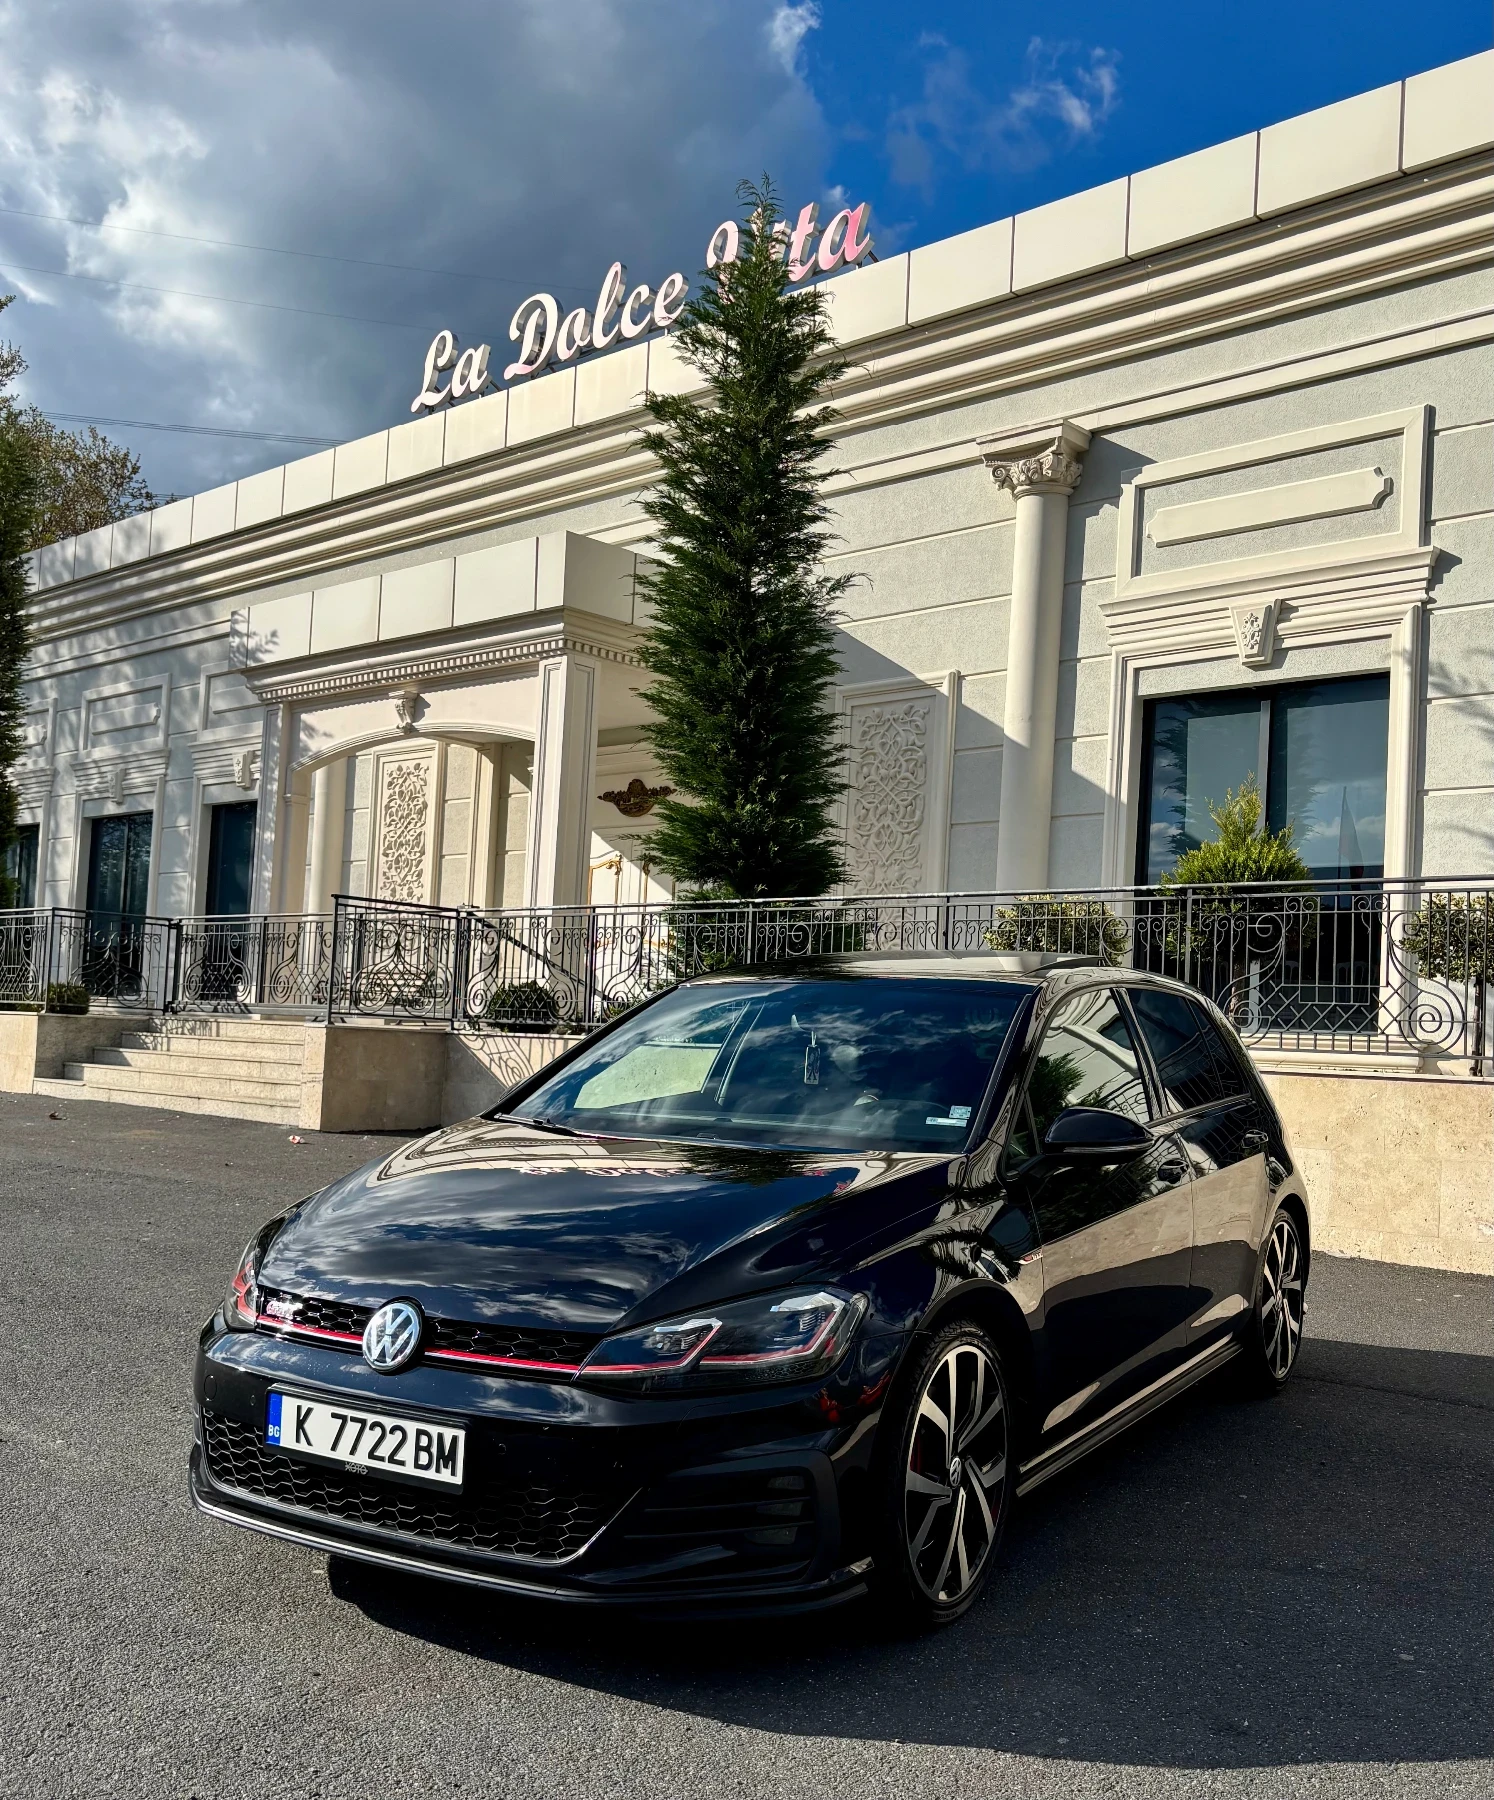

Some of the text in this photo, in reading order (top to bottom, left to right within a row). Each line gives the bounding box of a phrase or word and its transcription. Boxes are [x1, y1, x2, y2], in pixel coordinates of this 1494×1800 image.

[411, 328, 490, 413] La
[504, 261, 688, 380] Dolce
[268, 1424, 280, 1437] BG
[295, 1404, 314, 1447] K
